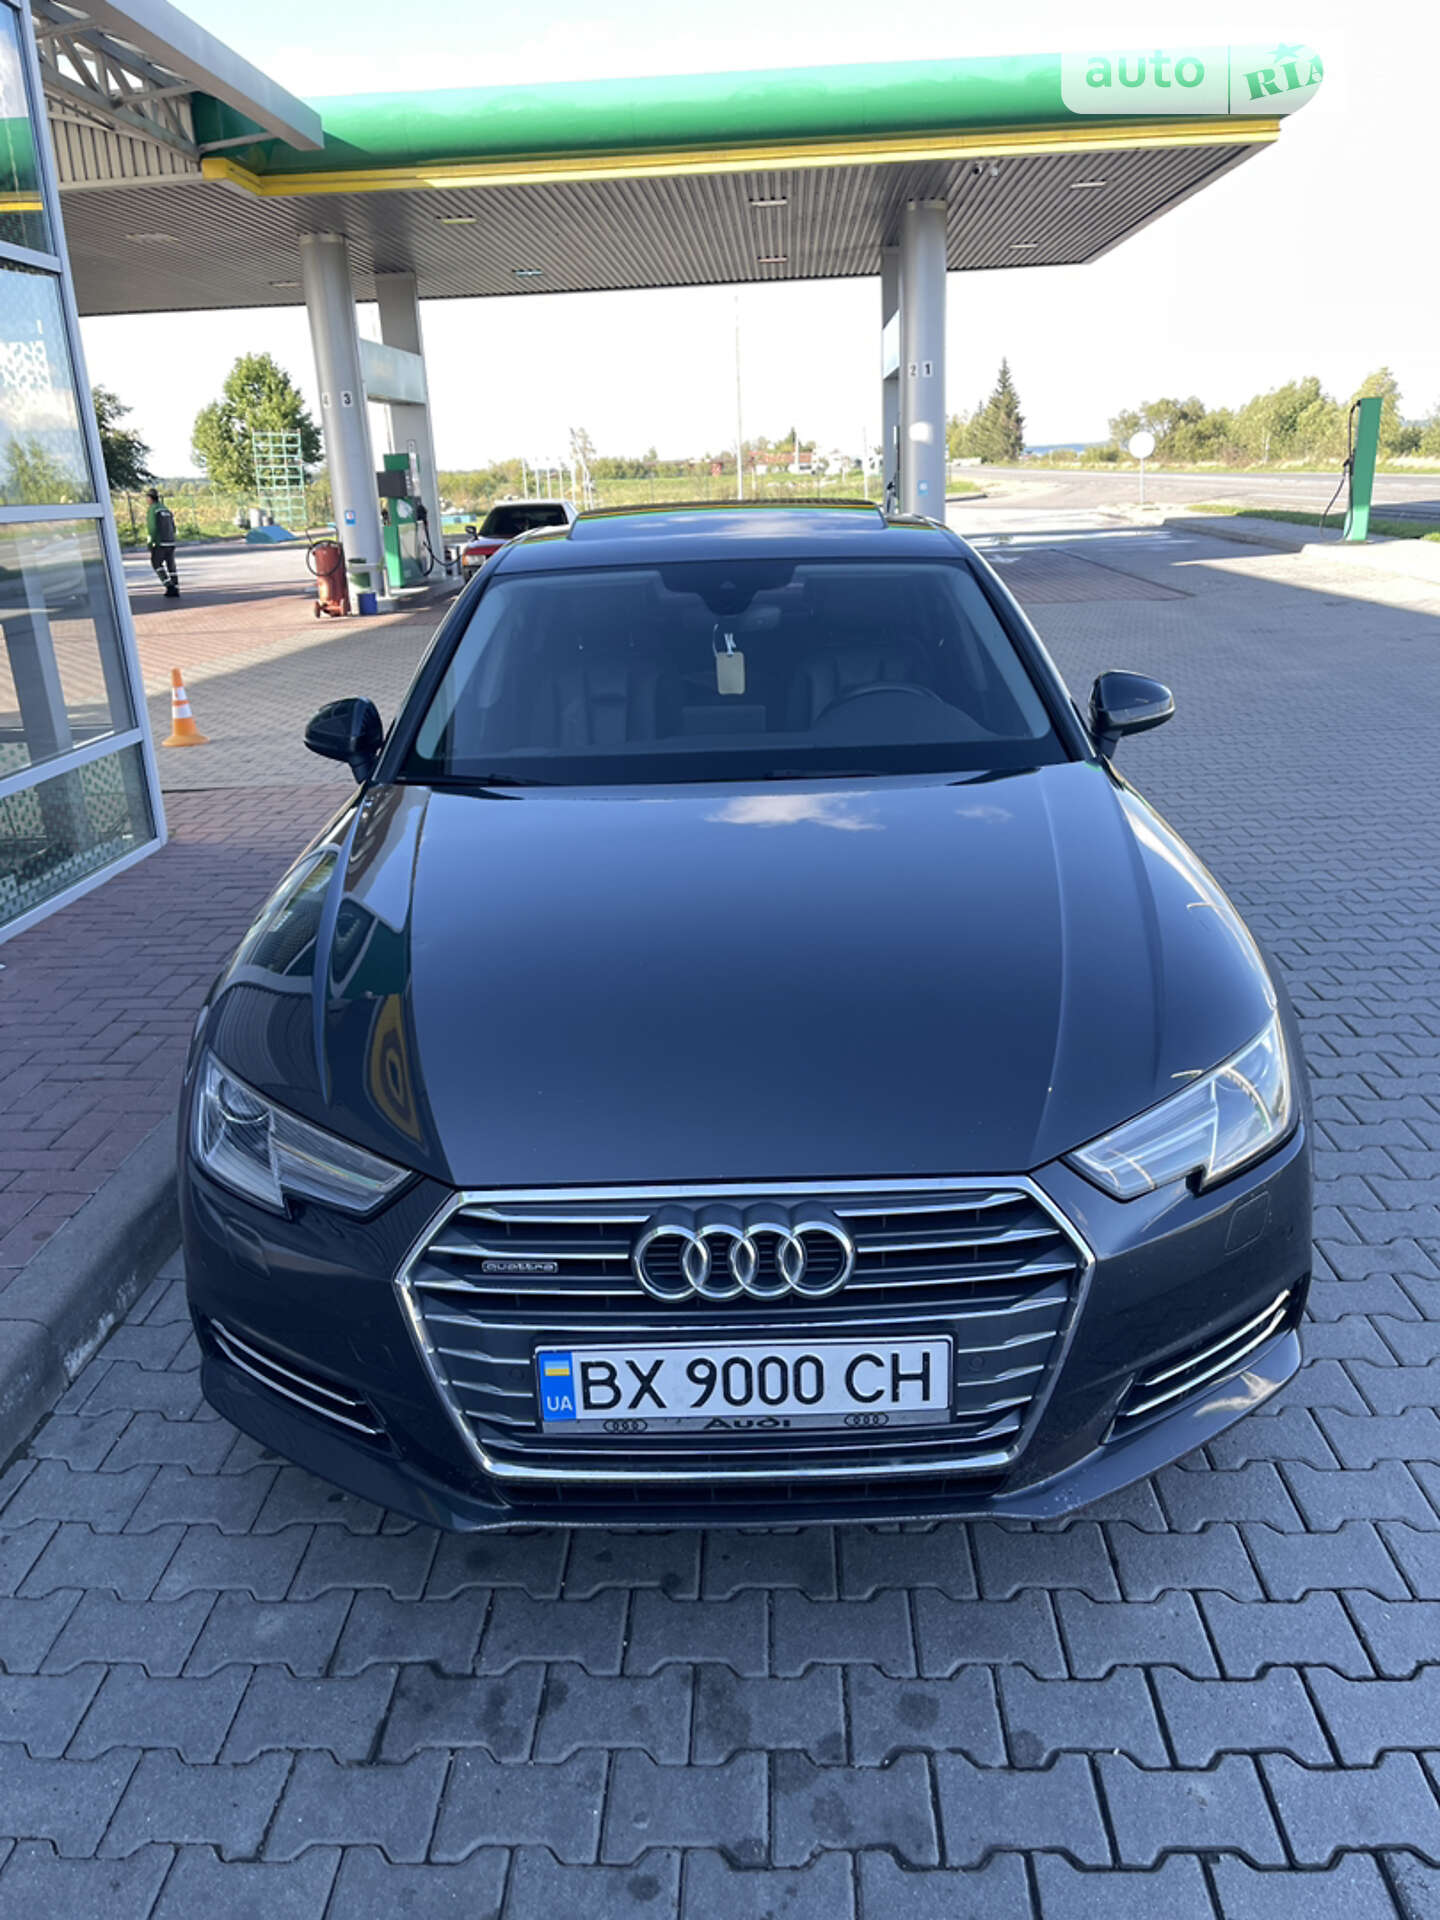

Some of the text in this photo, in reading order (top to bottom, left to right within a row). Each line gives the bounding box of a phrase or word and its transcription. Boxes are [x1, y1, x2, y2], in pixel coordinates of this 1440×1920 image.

[910, 363, 931, 376] 2 1
[343, 393, 351, 405] 3
[579, 1351, 931, 1411] BX 9000 CH
[546, 1396, 573, 1411] UA
